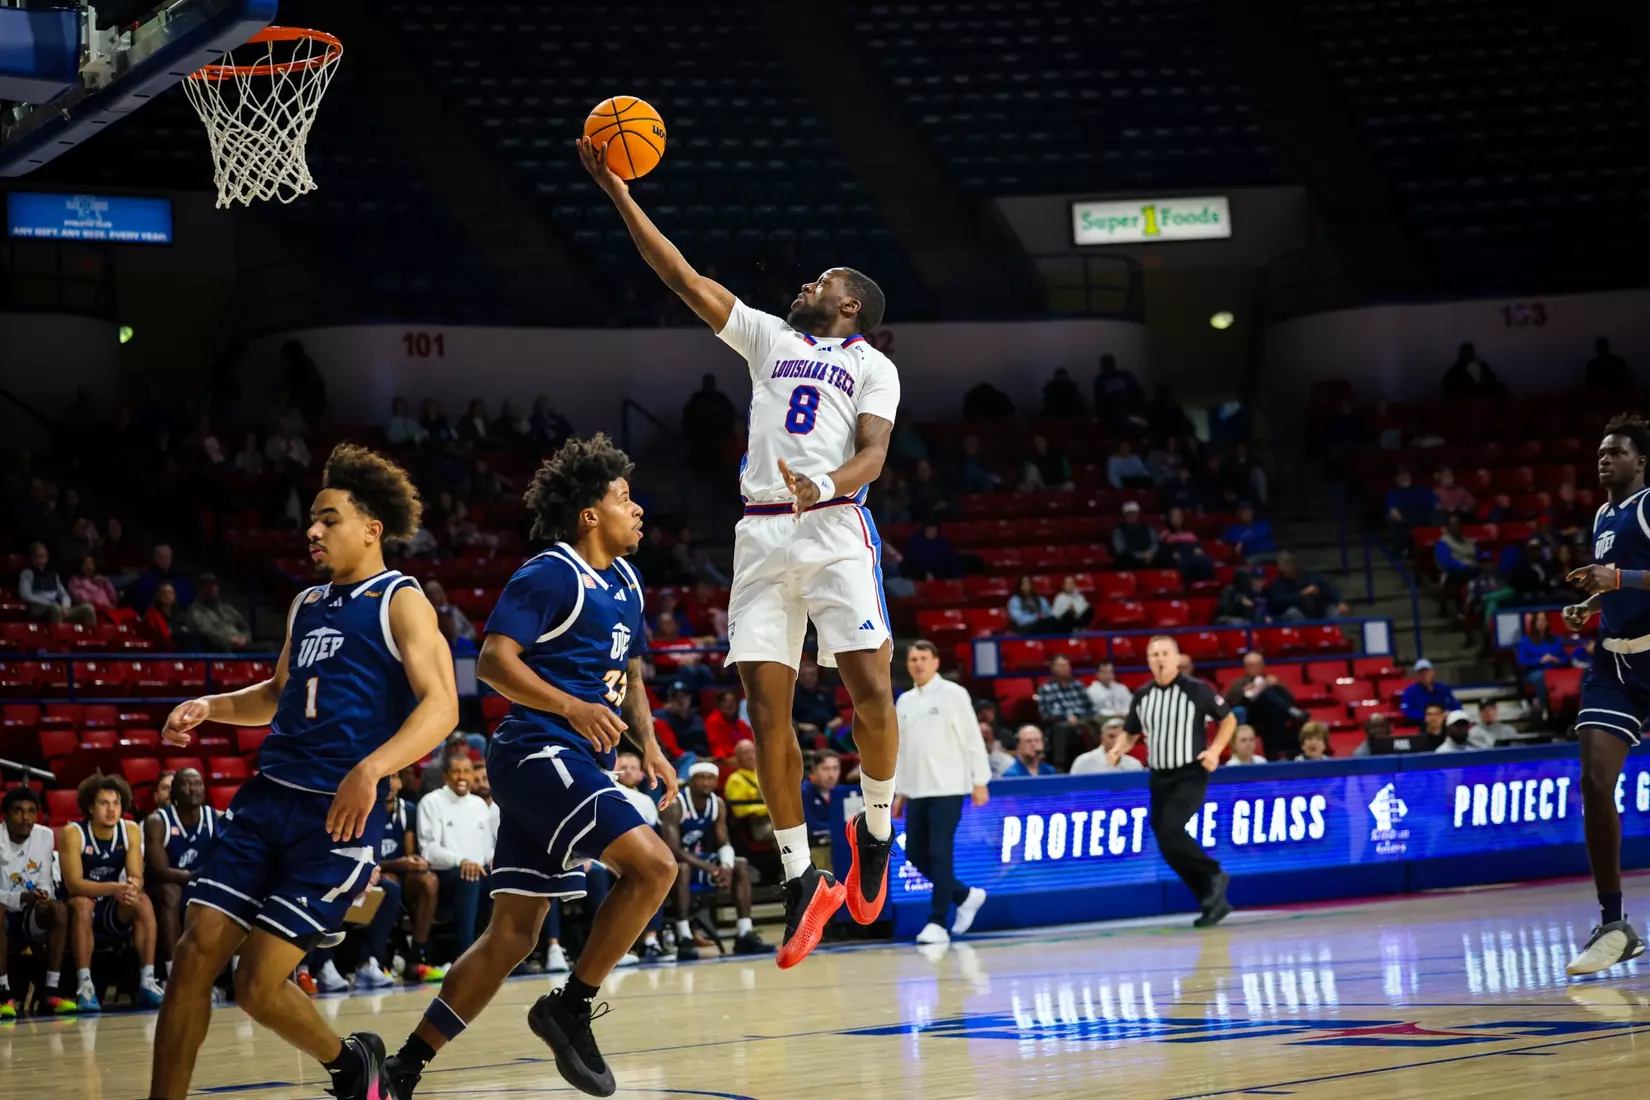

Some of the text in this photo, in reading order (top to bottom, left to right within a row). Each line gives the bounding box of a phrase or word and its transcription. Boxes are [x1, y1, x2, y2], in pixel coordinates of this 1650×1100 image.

[1081, 204, 1220, 236] Super 1 Foods
[402, 331, 444, 357] 101
[771, 360, 829, 380] LOUISIANA
[784, 384, 820, 435] 8
[297, 626, 345, 668] UTEP
[305, 677, 318, 718] 1
[1454, 777, 1570, 827] PROTECT
[1001, 807, 1148, 863] PROTECT
[1231, 795, 1327, 845] GLASS
